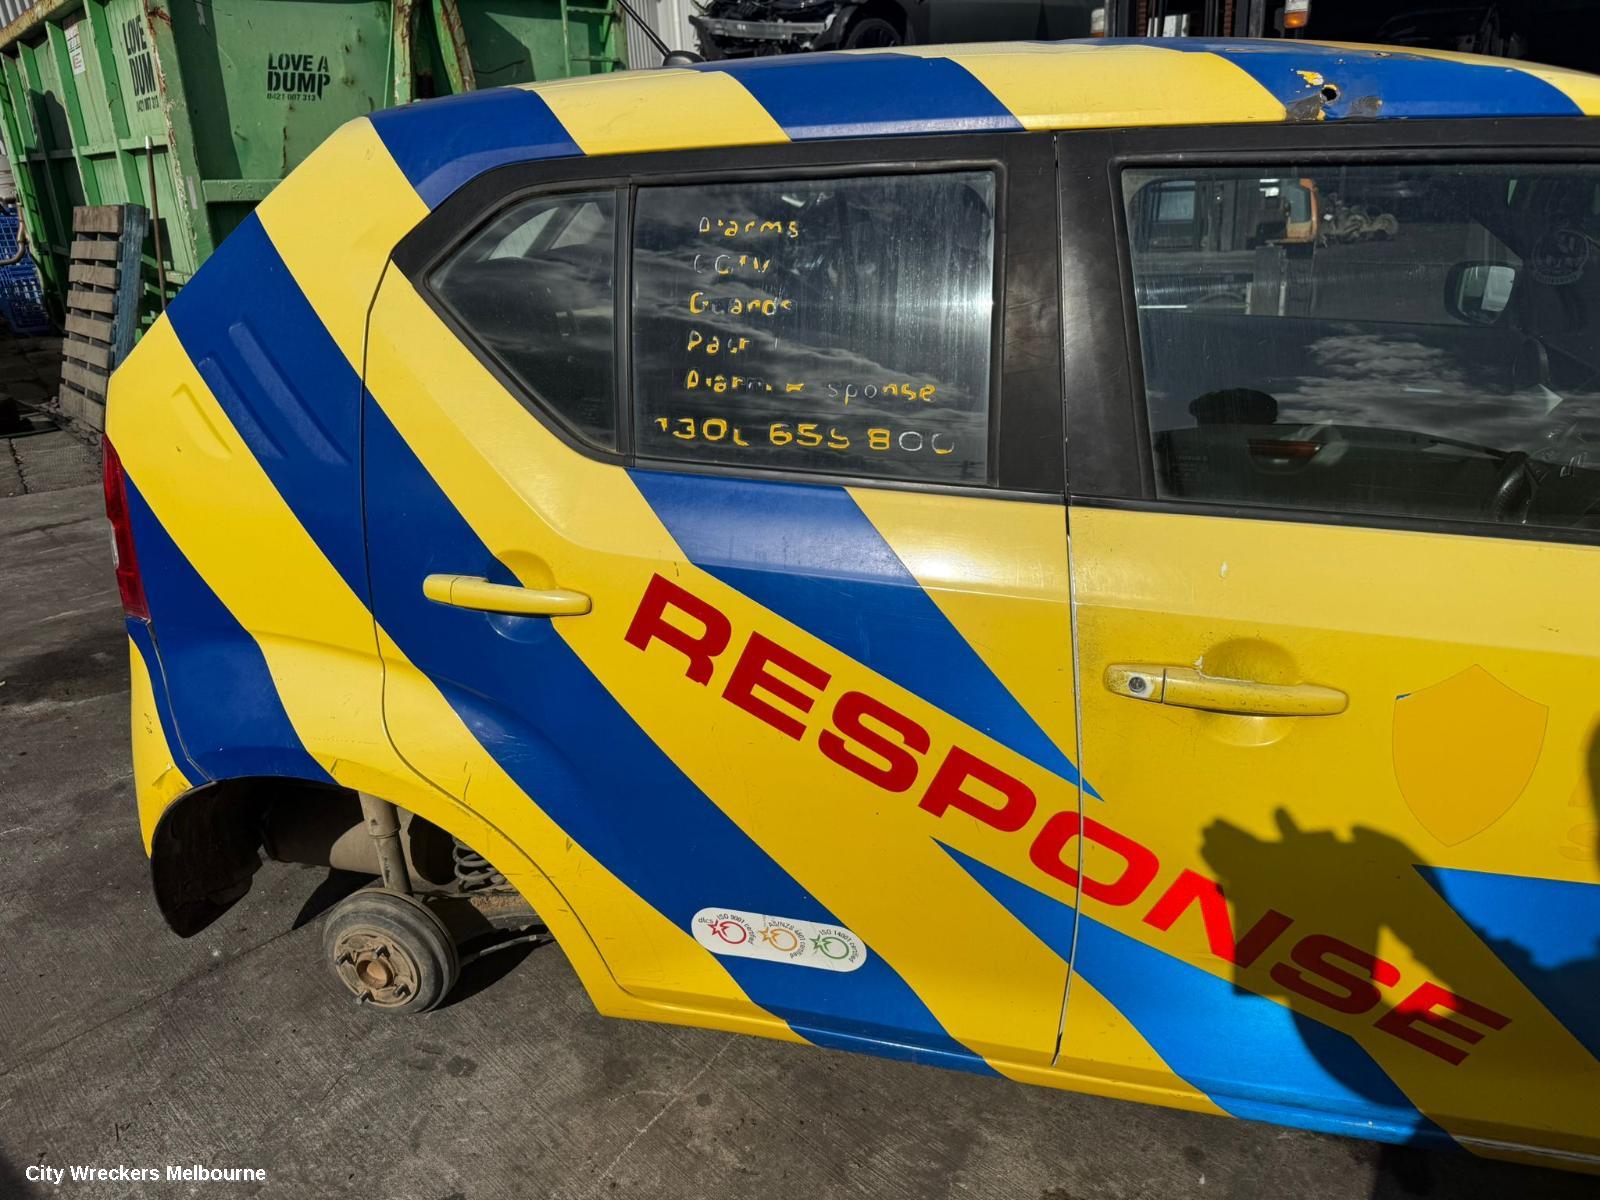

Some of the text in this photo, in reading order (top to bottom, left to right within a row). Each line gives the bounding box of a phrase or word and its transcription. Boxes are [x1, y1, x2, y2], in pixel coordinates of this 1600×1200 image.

[122, 14, 148, 56] LOVE
[268, 52, 329, 72] LOVE A
[266, 93, 285, 101] 0421
[267, 71, 331, 101] DUMP
[624, 573, 1512, 1067] RESPONSE
